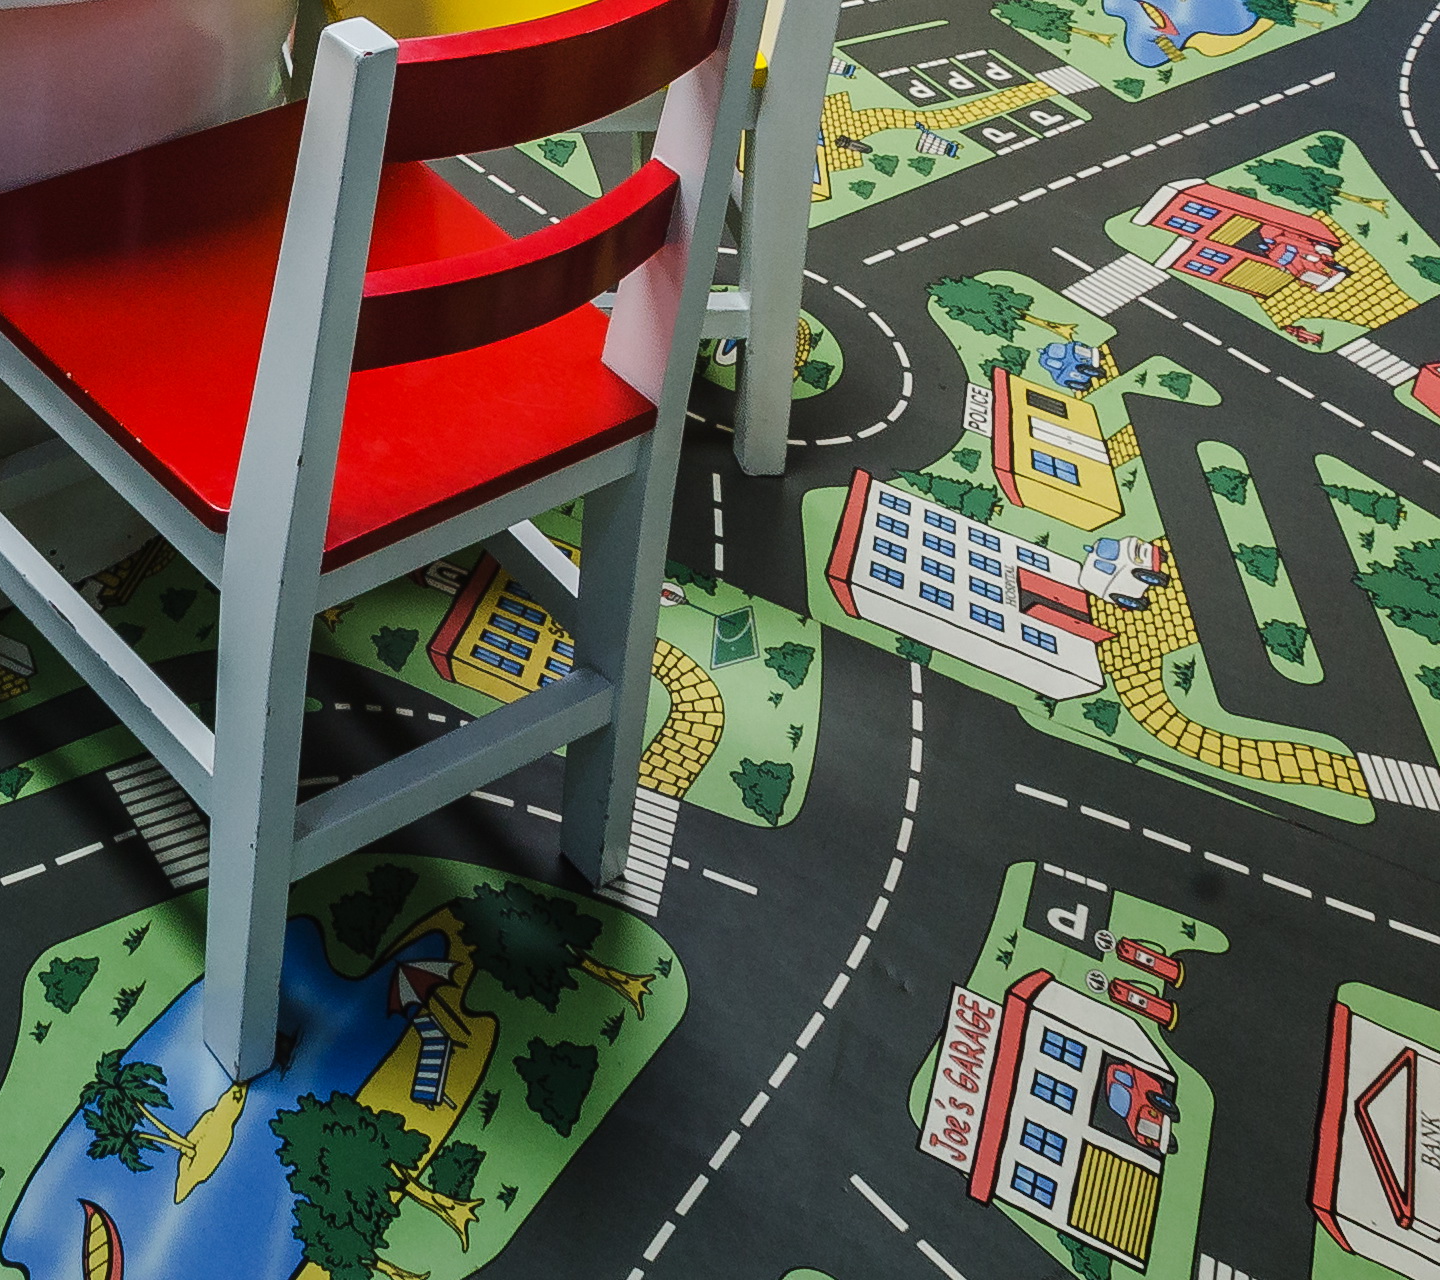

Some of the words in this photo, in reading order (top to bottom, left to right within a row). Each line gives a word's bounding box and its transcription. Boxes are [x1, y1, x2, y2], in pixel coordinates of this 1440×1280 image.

[969, 386, 989, 432] POLICE
[1048, 904, 1088, 940] P
[948, 992, 997, 1097] GARAGE
